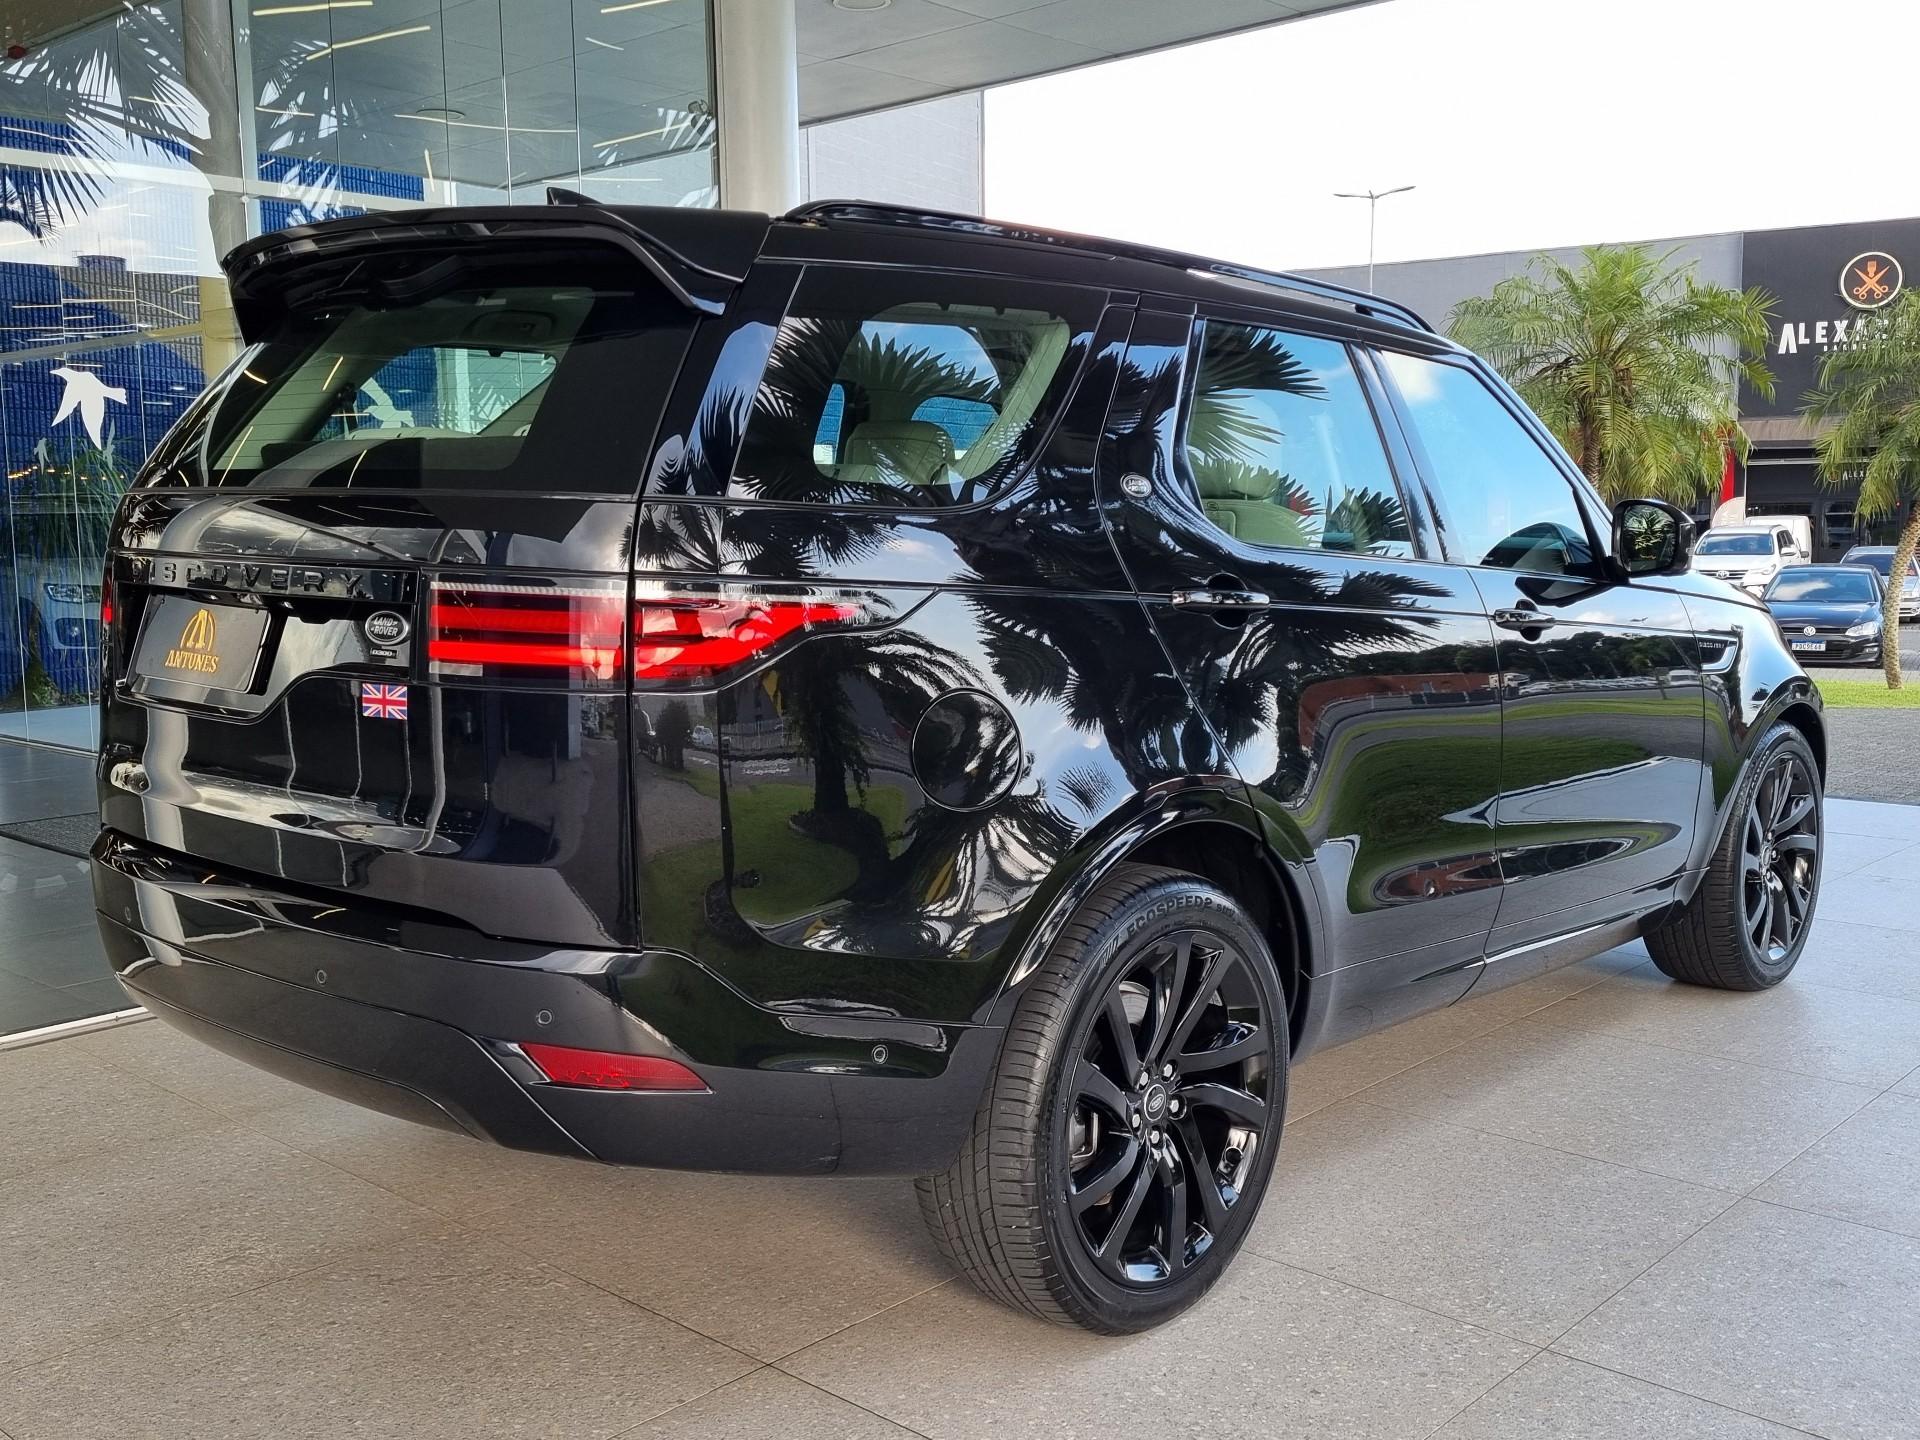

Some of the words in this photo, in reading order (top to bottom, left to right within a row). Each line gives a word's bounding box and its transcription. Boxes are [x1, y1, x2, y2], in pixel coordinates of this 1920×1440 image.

[132, 559, 362, 597] DISCOVERY
[373, 616, 394, 627] LAND
[373, 625, 399, 637] ROVER
[164, 649, 219, 673] ANTUNES
[1126, 895, 1213, 940] ECOSPEED2
